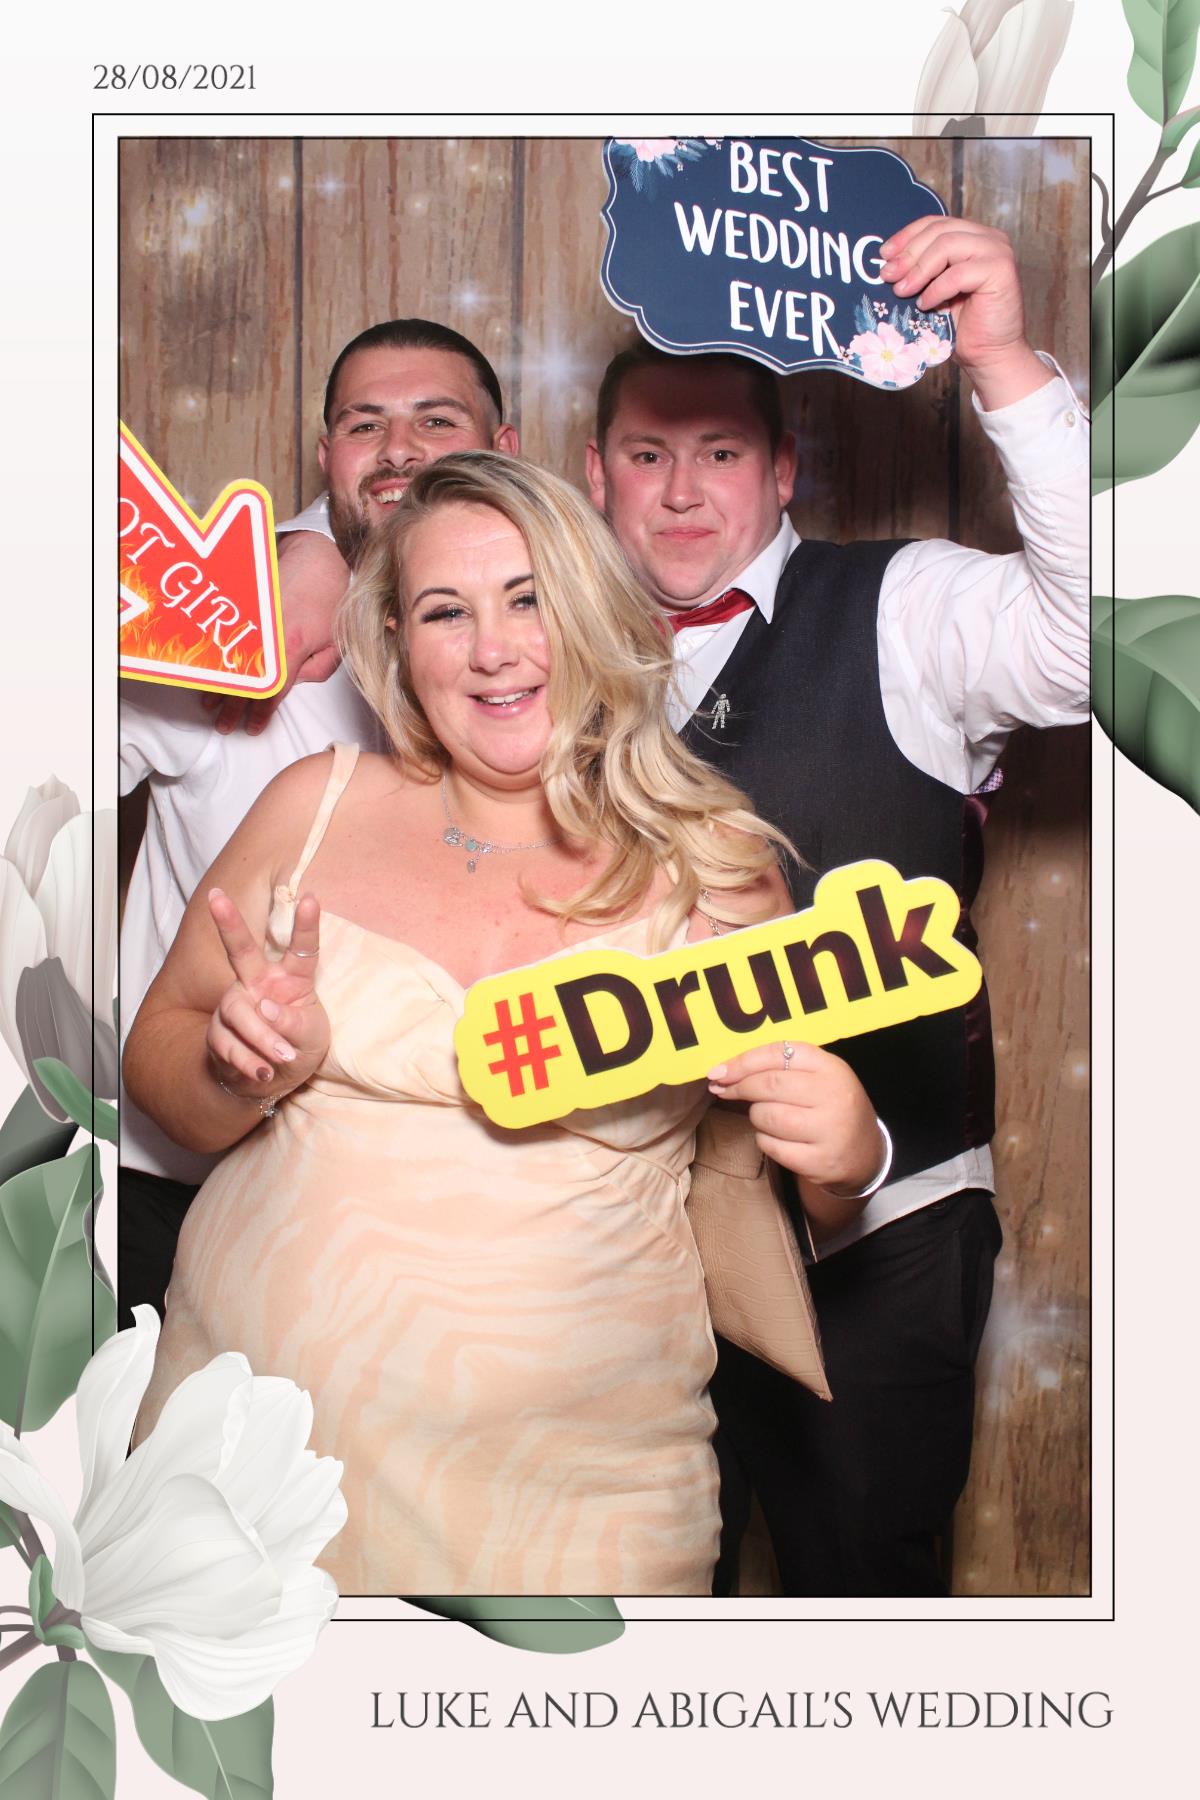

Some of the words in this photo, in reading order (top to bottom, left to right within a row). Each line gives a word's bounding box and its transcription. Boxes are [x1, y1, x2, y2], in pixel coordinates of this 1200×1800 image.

[730, 141, 834, 213] BEST
[673, 201, 887, 286] WEDDING
[729, 280, 840, 357] EVER
[159, 561, 258, 670] GIRL
[482, 884, 960, 1098] #Drunk
